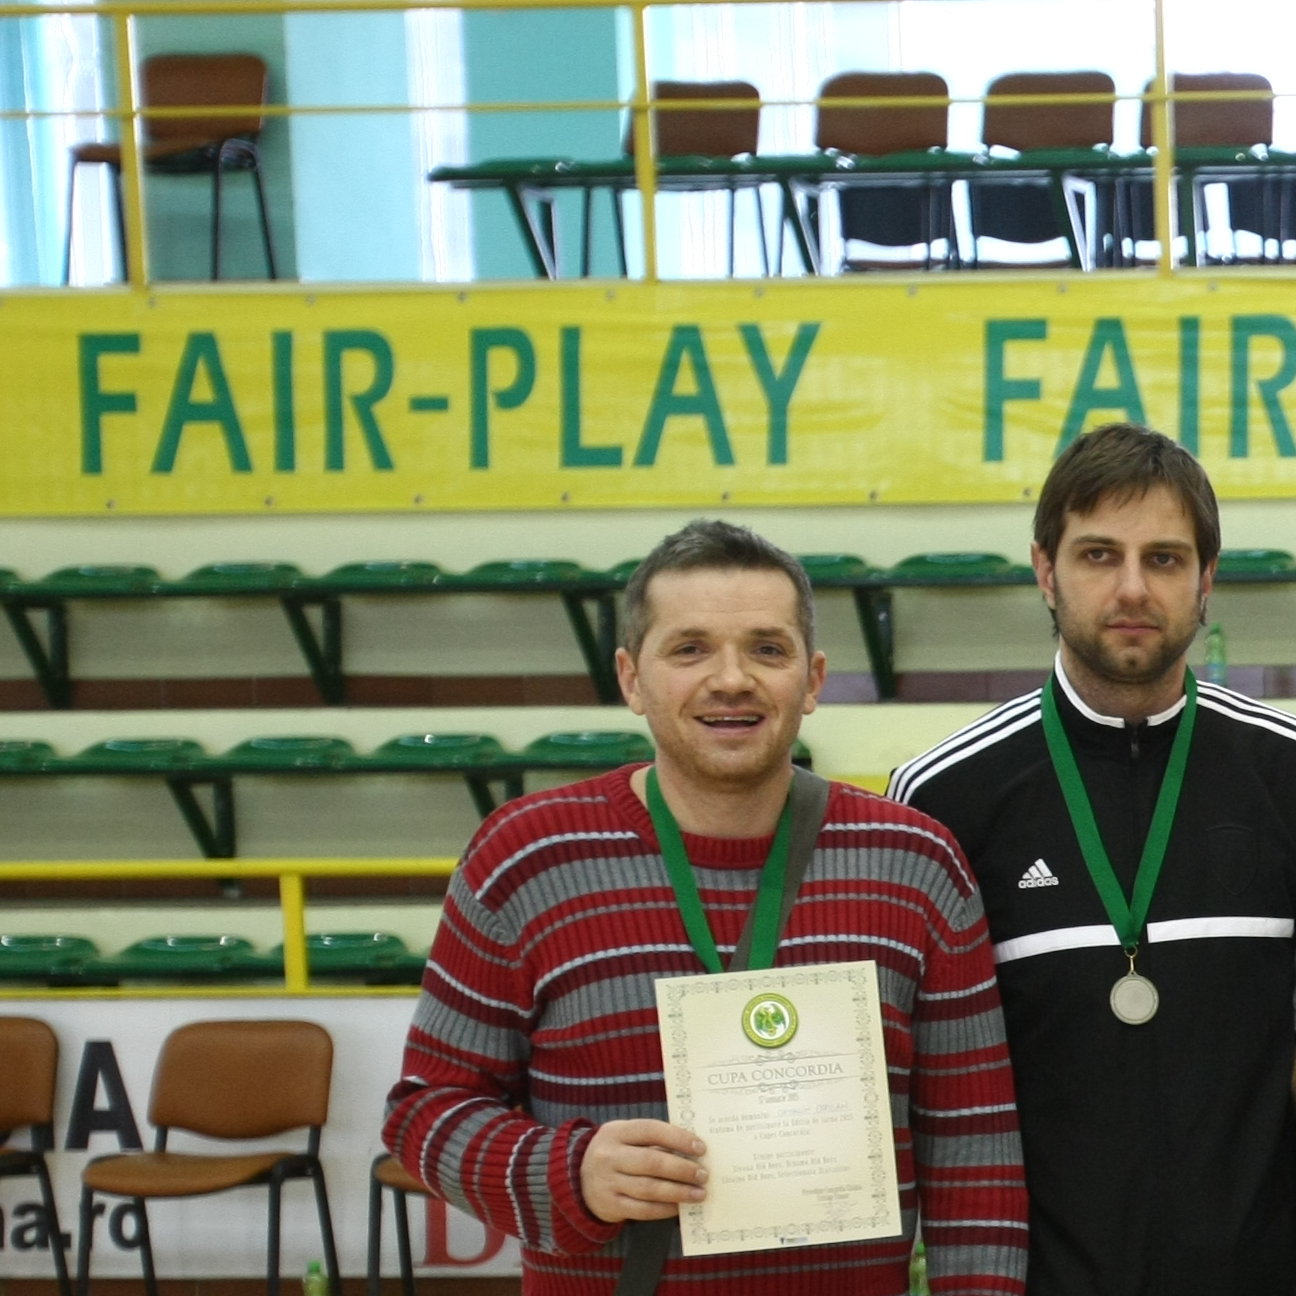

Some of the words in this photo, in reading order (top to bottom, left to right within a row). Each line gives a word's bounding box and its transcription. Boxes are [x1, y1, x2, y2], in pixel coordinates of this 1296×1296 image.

[77, 321, 822, 475] FAIR-PLAY
[1018, 875, 1059, 889] adidas
[707, 1072, 747, 1085] CUPA
[751, 1063, 843, 1081] CONCORDIA
